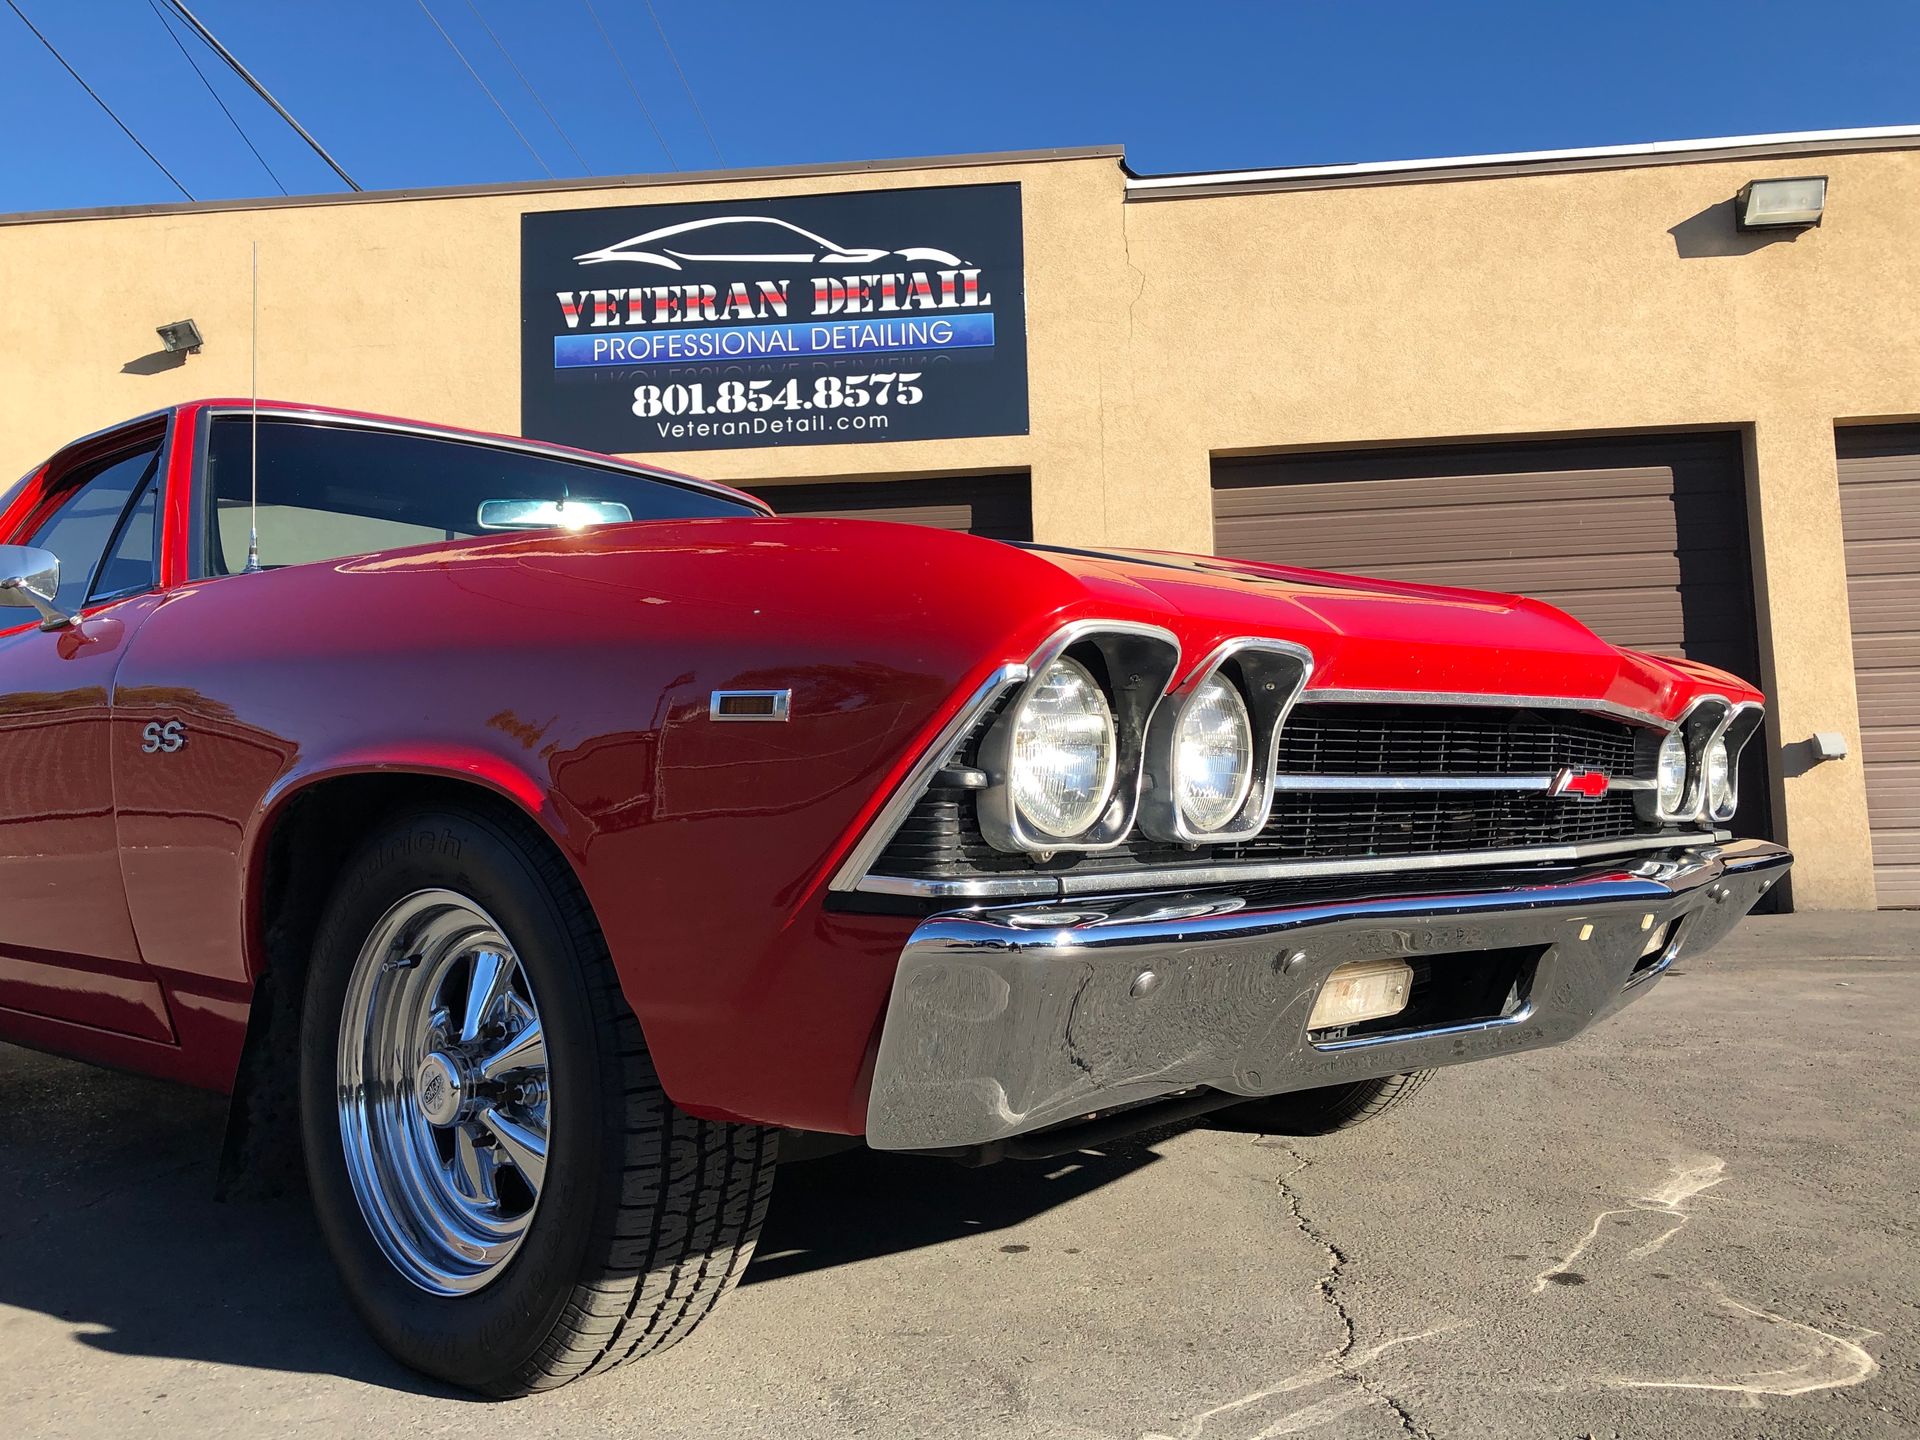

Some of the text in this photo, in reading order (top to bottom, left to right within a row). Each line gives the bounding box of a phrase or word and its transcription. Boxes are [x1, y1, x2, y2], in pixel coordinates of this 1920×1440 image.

[556, 268, 992, 329] VETERAN DETAIL
[594, 320, 953, 361] PROFESSIONAL DETAILING
[631, 371, 924, 418] 801.854.8575
[656, 414, 889, 438] VeteranDetail.com
[141, 720, 185, 753] SS
